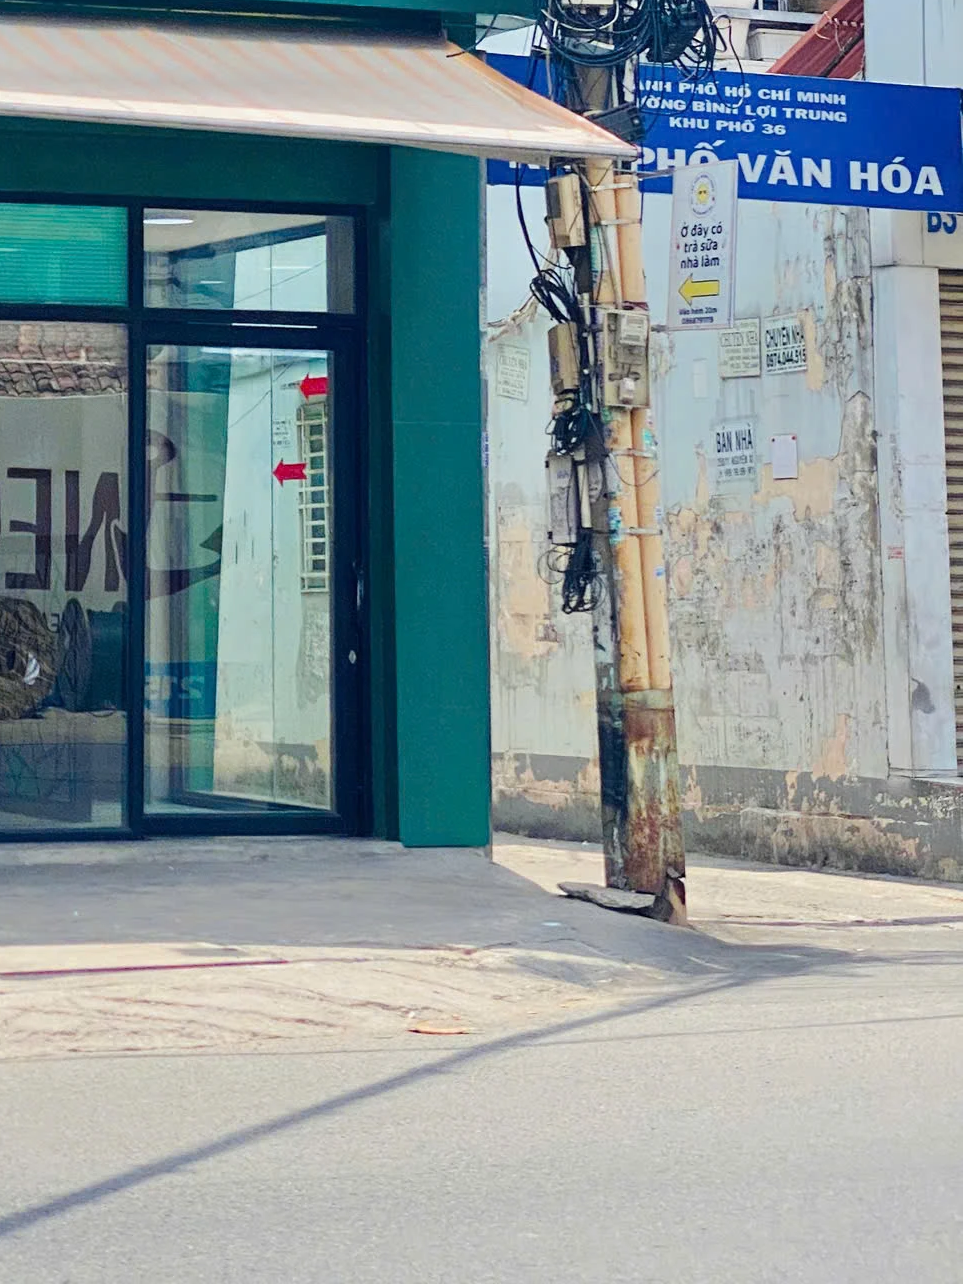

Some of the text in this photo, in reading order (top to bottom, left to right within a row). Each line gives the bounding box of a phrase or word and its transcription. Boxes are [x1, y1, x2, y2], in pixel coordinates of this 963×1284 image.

[678, 81, 719, 95] PHỐ
[758, 88, 791, 101] CHÍ
[797, 91, 846, 105] MINH
[692, 99, 738, 114] BÌNH
[745, 105, 777, 118] LỢI
[782, 107, 847, 123] TRUNG
[669, 117, 786, 135] KHU PHỐ 36
[737, 150, 832, 188] VĂN
[850, 156, 944, 196] HÓA
[691, 223, 708, 238] đây
[711, 221, 723, 234] có
[680, 255, 720, 269] nhà làm
